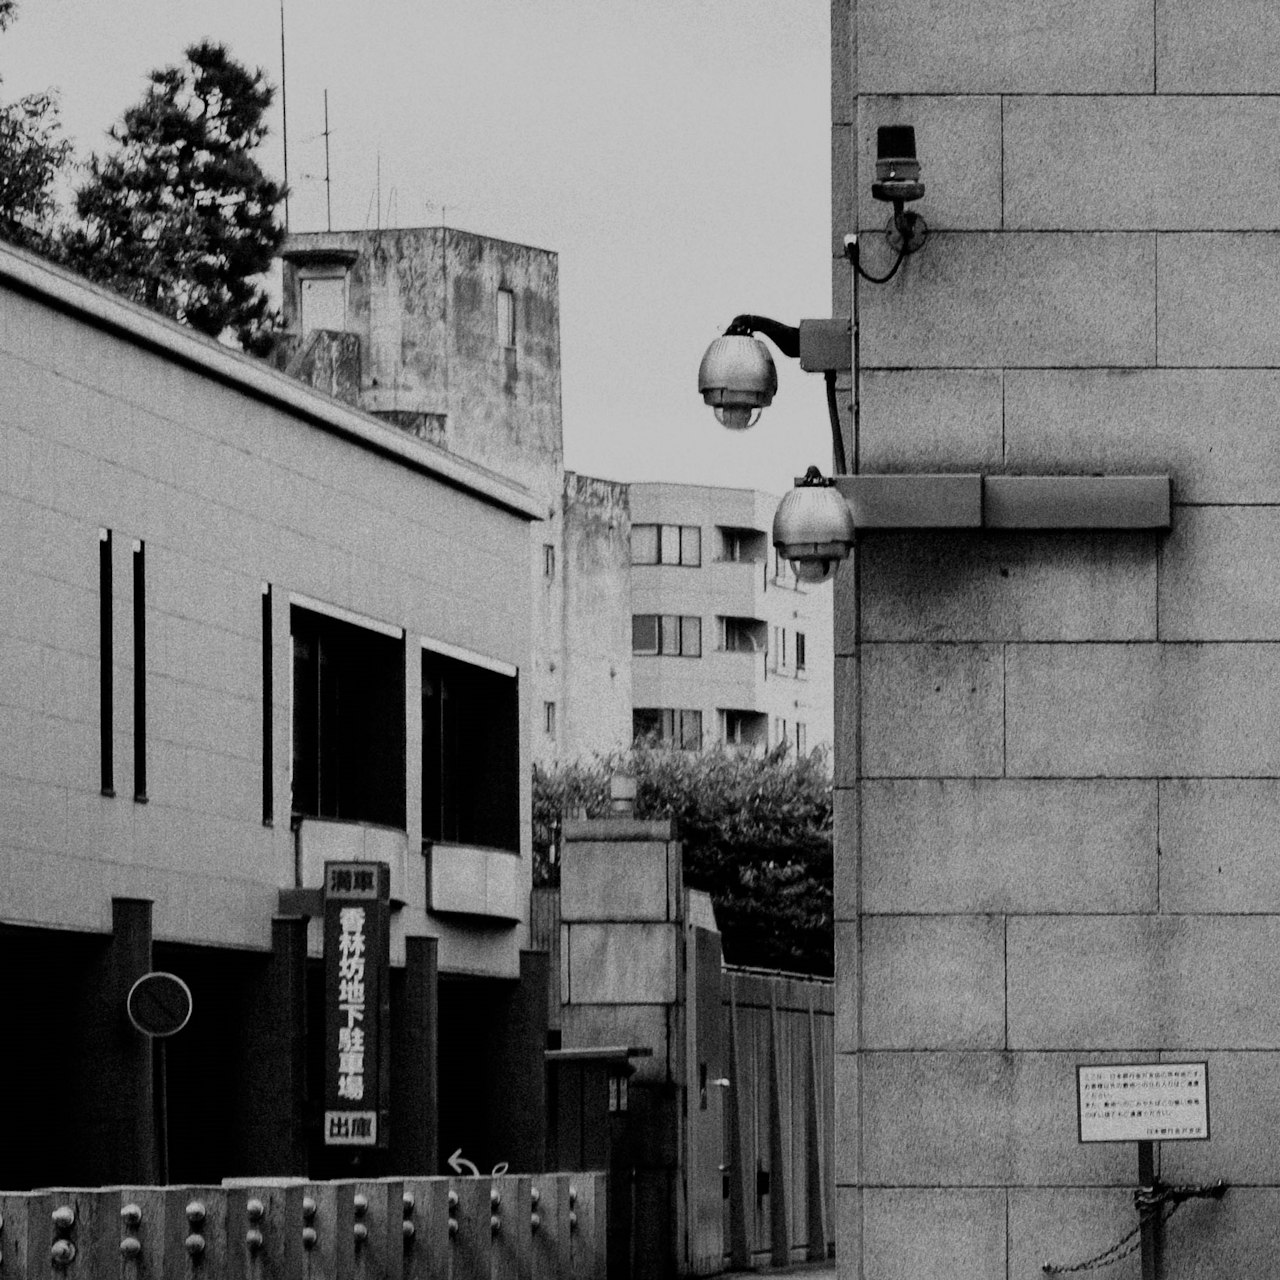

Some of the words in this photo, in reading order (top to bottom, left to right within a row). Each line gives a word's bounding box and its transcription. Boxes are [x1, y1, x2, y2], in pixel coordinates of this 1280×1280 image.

[338, 908, 366, 1100] 香林坊地下駐車場
[330, 1117, 372, 1137] 出庫
